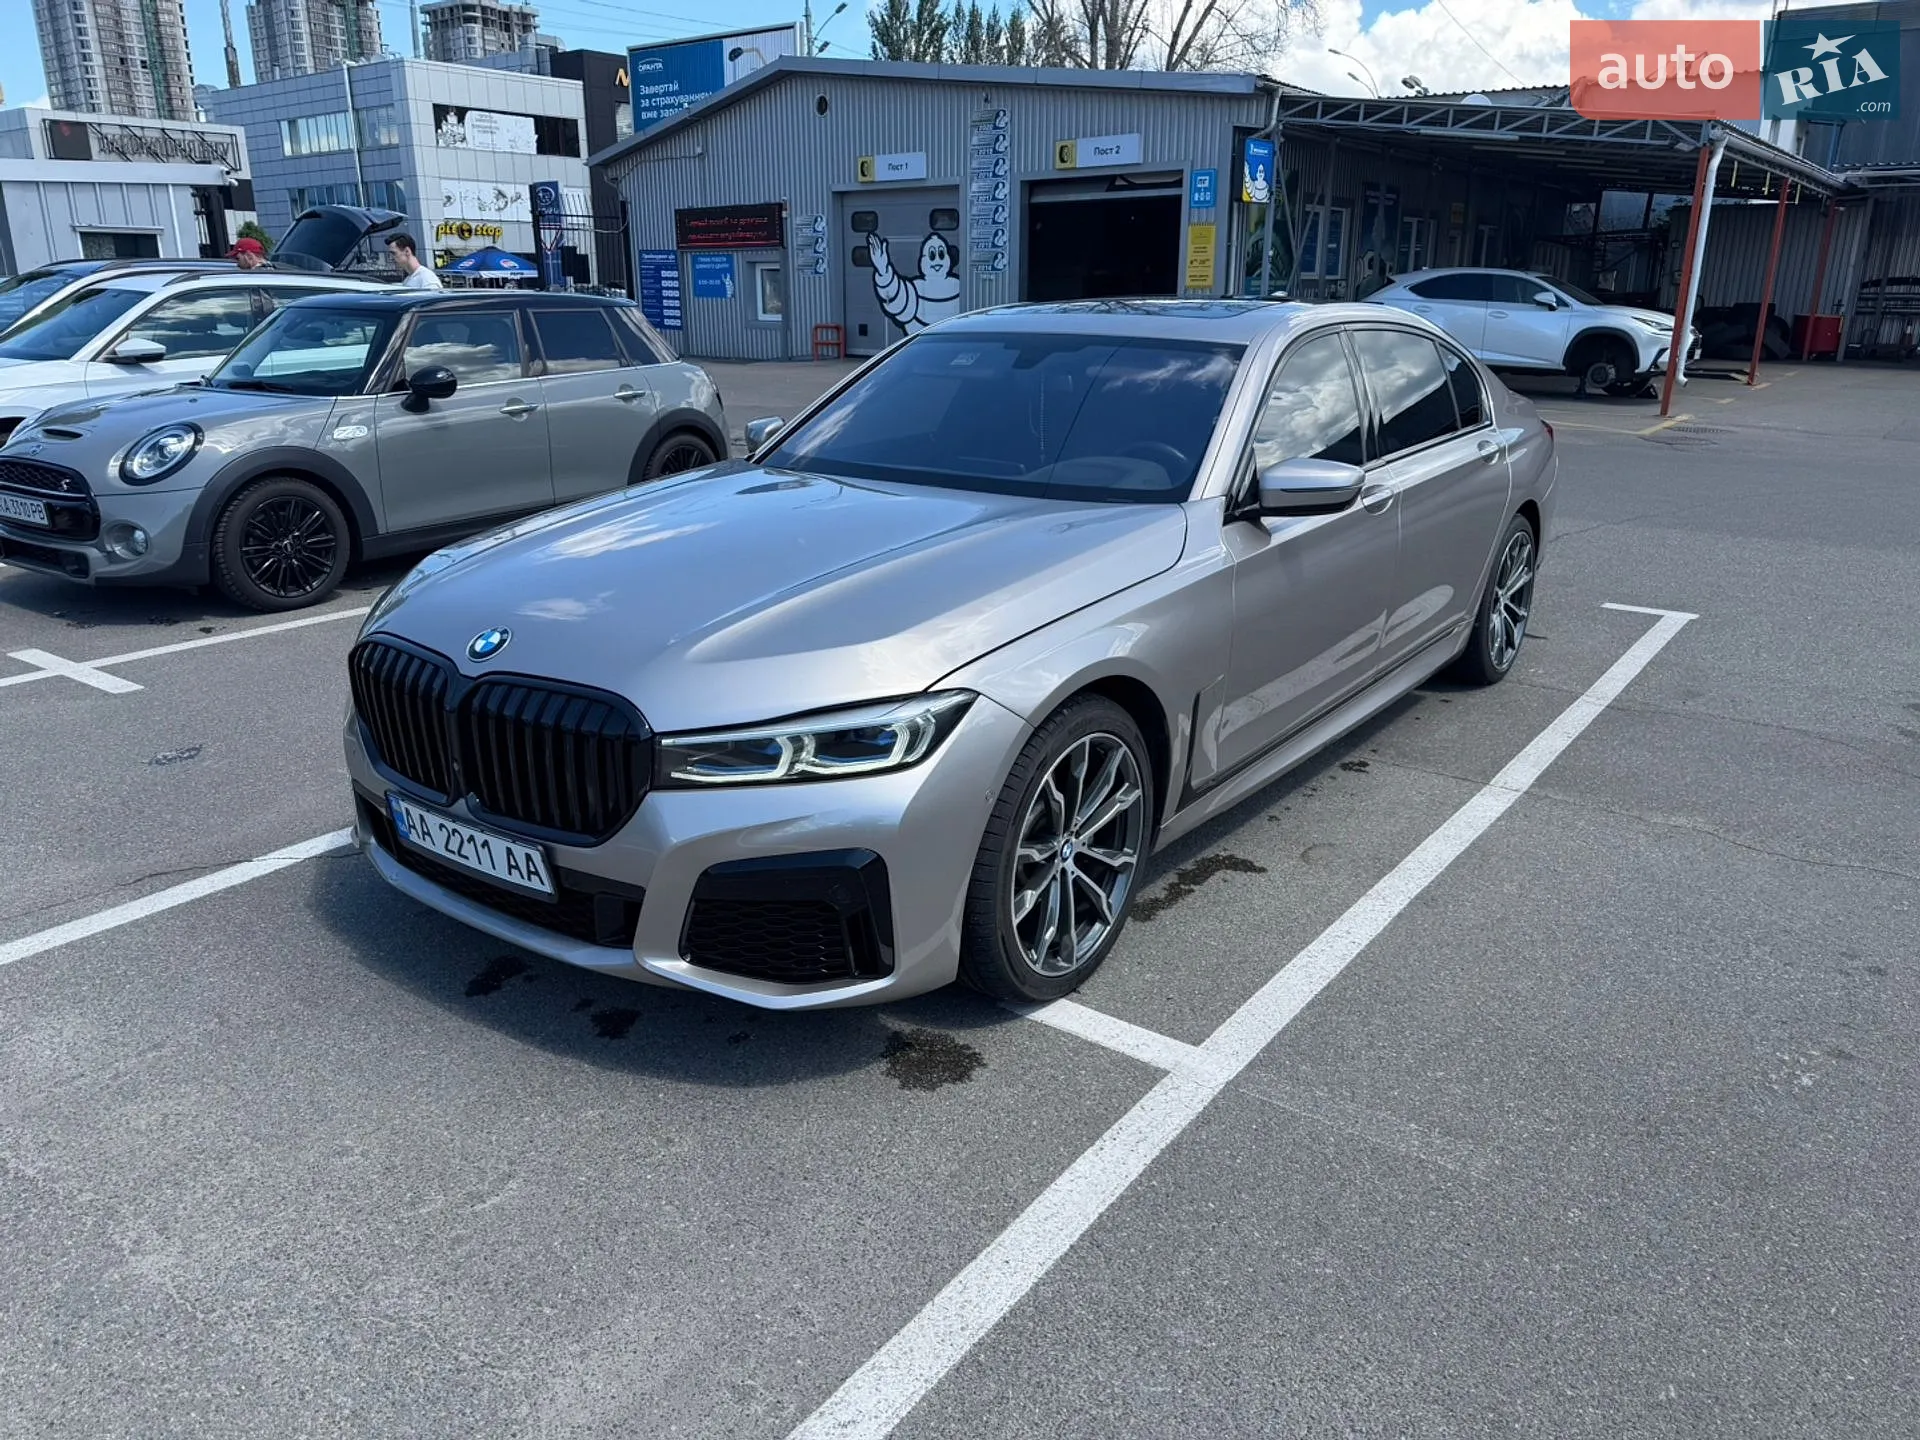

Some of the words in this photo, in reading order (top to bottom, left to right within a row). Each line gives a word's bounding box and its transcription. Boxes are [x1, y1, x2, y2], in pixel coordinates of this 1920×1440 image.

[639, 80, 679, 96] Завертай
[640, 98, 650, 108] за
[641, 110, 658, 119] вже
[1093, 146, 1113, 156] Пост
[1115, 145, 1121, 154] 2
[887, 162, 904, 171] Пост
[404, 807, 436, 846] AA
[438, 823, 497, 871] 2211
[505, 846, 545, 886] AA
